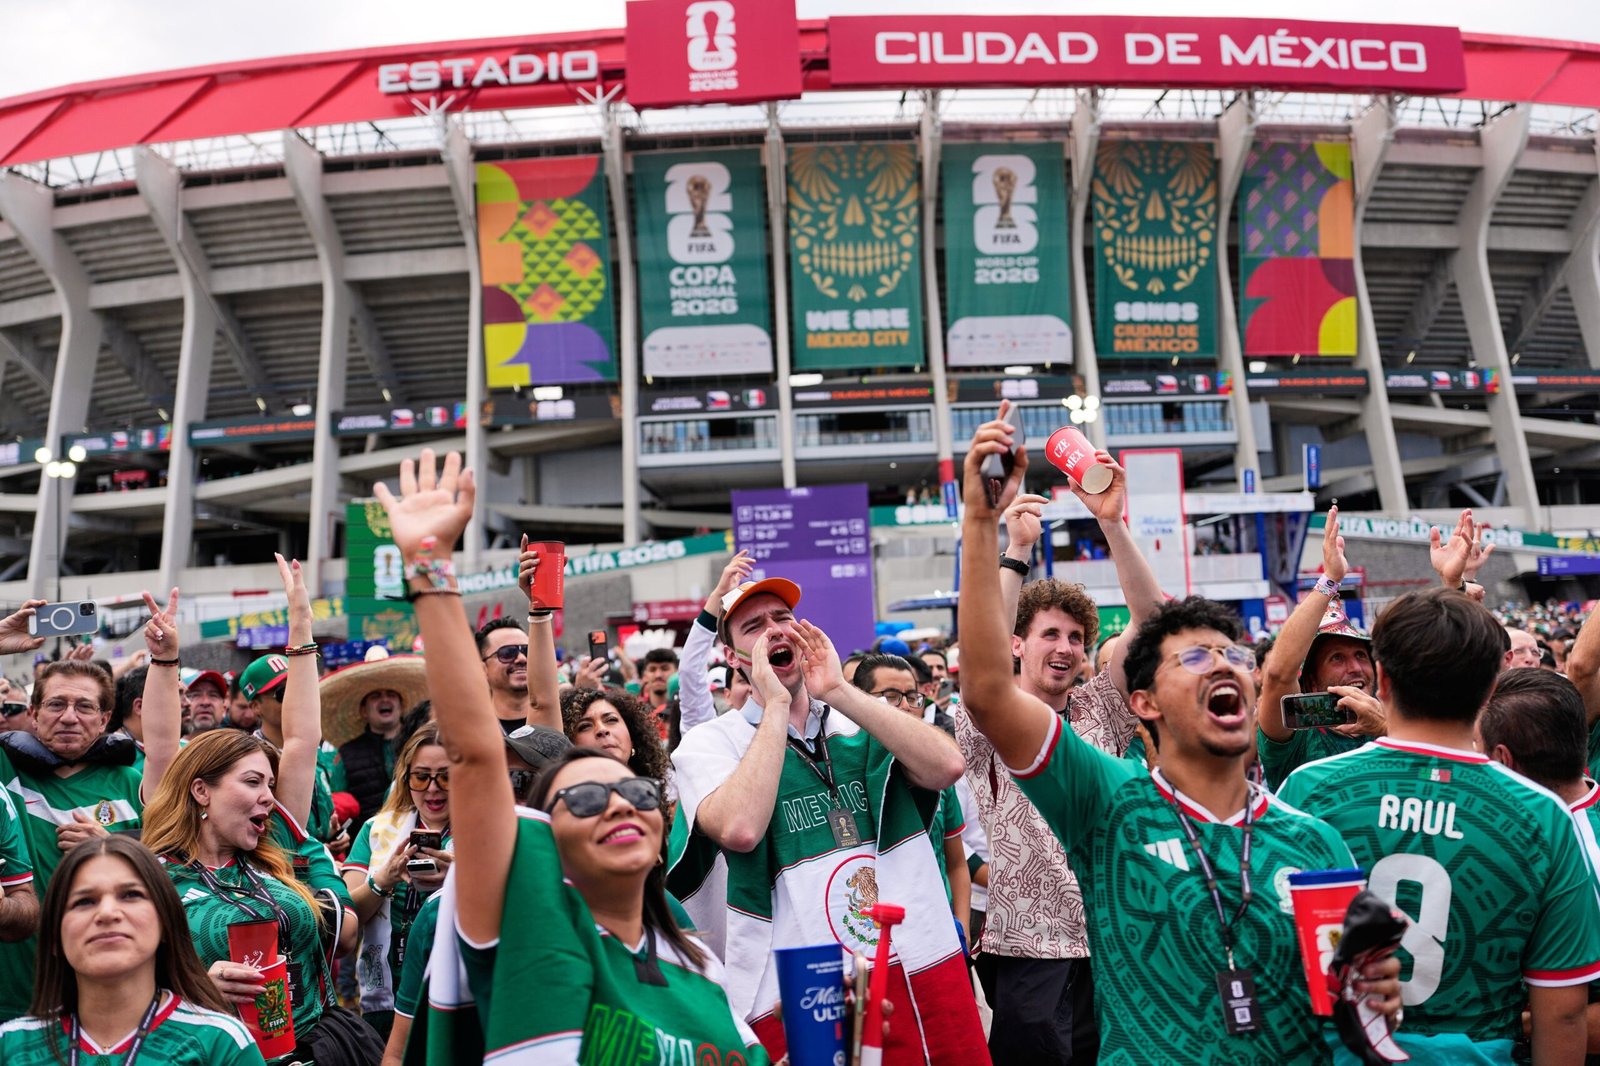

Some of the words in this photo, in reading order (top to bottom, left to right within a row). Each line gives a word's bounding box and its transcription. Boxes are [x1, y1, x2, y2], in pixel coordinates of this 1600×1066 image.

[875, 31, 1099, 65] CIUDAD
[1125, 32, 1201, 65] DE
[1220, 28, 1427, 73] MÉXICO
[378, 50, 598, 93] ESTADIO
[688, 78, 739, 92] 2026
[687, 242, 717, 253] FIFA
[992, 234, 1021, 244] FIFA
[974, 258, 1013, 268] WORLD
[1015, 257, 1039, 266] CUP
[669, 264, 737, 286] COPA
[974, 268, 1040, 284] 2026
[670, 285, 738, 299] MUNDIAL
[671, 299, 739, 316] 2026
[806, 311, 850, 331] WE
[853, 308, 910, 329] ARE
[807, 332, 870, 348] MEXICO
[873, 330, 909, 346] CITY
[1114, 324, 1175, 338] CIUDAD
[1180, 323, 1199, 337] DE
[1053, 438, 1071, 459] CZE
[1065, 449, 1085, 472] MEX
[1372, 519, 1431, 541] WORLD
[1471, 527, 1523, 548] 026
[456, 569, 516, 595] NDIAL
[573, 552, 617, 575] FIFA
[617, 540, 687, 567] 2026
[782, 780, 869, 833] MEXIC
[1378, 794, 1464, 840] RAUL
[813, 1004, 846, 1022] ULT
[269, 1017, 285, 1028] FIFA
